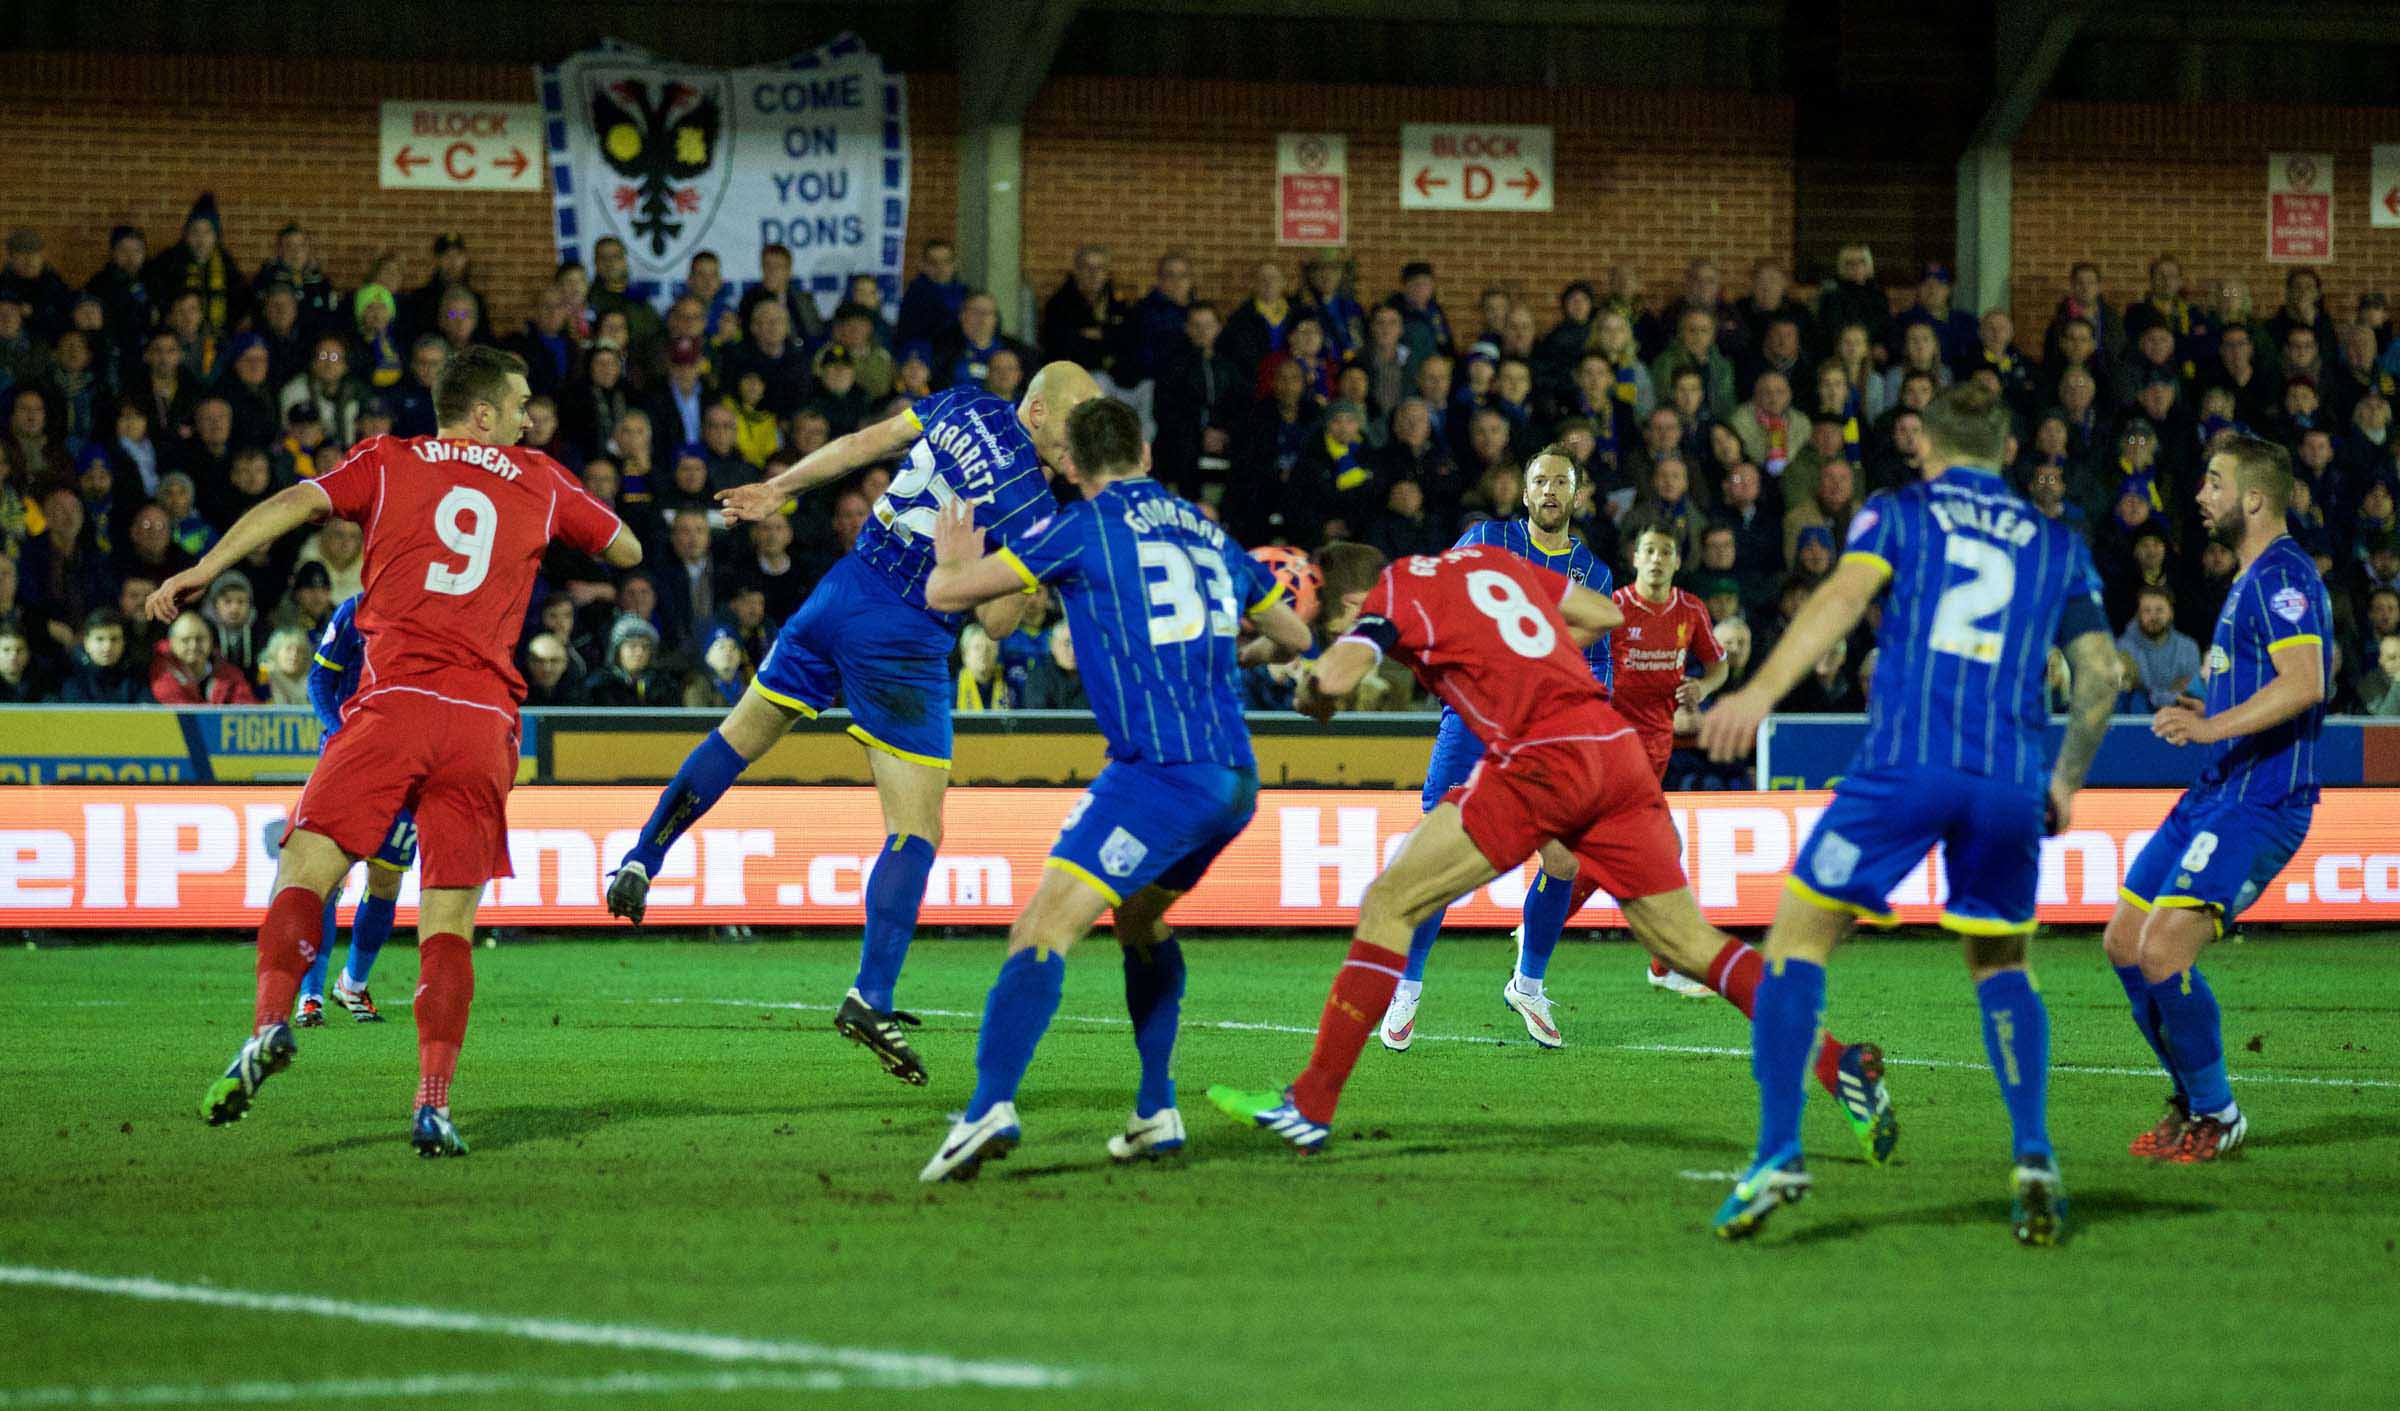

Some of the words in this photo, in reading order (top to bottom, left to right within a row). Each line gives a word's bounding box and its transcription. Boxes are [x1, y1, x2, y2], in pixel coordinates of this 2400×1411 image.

[754, 75, 863, 114] COME
[412, 111, 508, 137] BLOCK
[785, 126, 837, 158] ON
[444, 142, 477, 181] C
[1430, 134, 1521, 159] BLOCK
[772, 170, 848, 202] YOU
[1464, 165, 1495, 200] D
[760, 214, 864, 248] DONS
[411, 440, 523, 481] LAMBERT
[928, 420, 996, 507] BARRETT
[423, 485, 498, 596] 9
[1137, 540, 1241, 646] 33
[1929, 533, 2016, 664] 2
[1465, 569, 1556, 659] 8
[2181, 831, 2219, 873] 8
